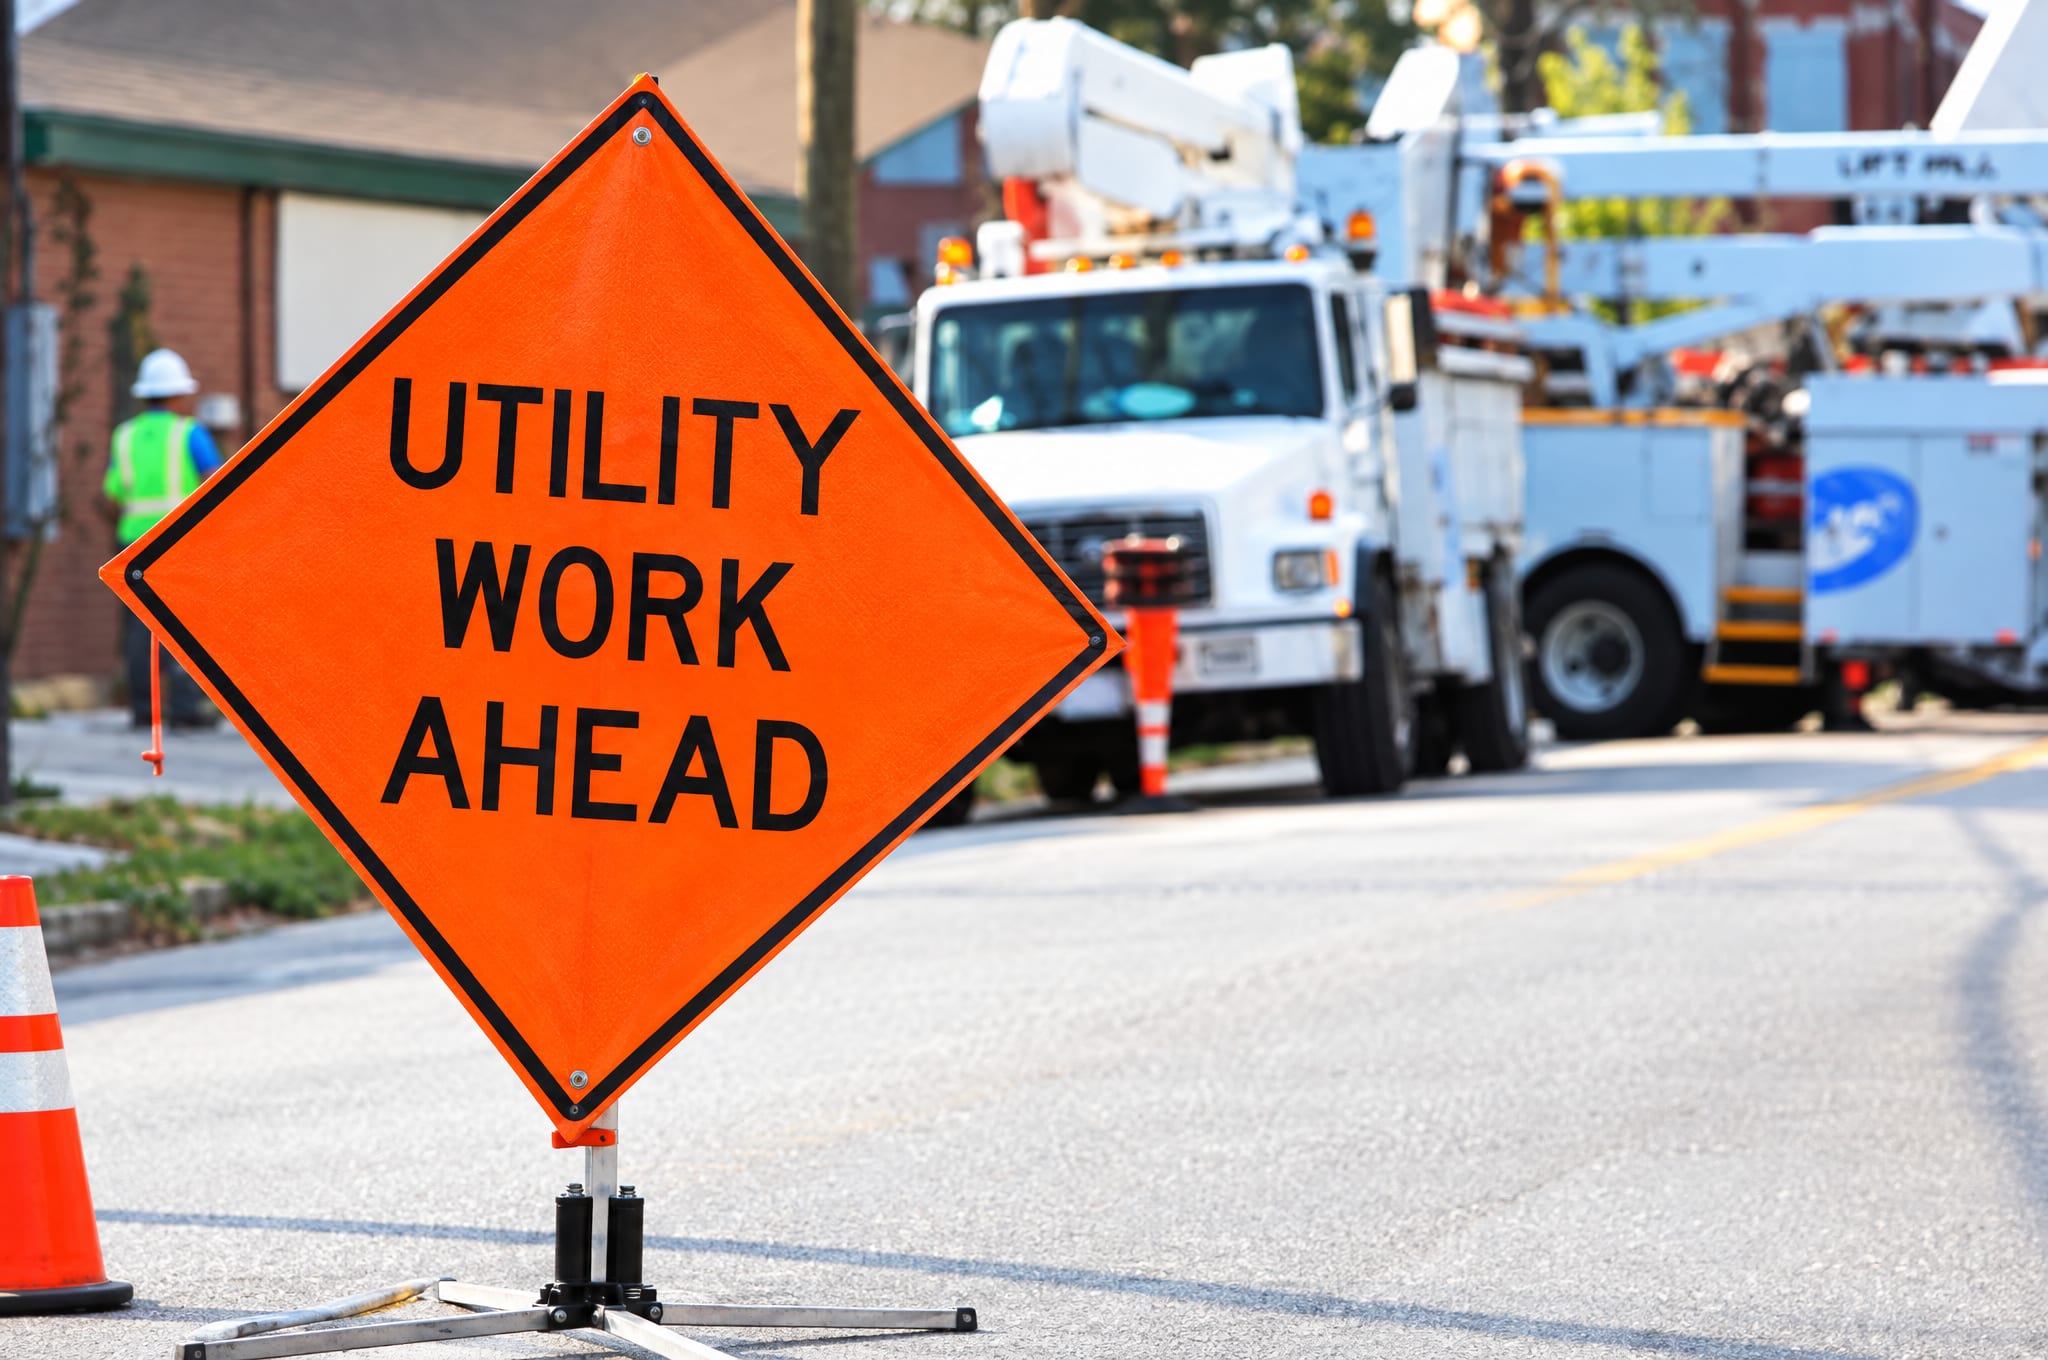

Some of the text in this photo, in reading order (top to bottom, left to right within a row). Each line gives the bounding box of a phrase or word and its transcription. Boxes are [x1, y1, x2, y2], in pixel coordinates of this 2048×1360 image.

[389, 377, 861, 516] UTILITY
[435, 538, 795, 672] WORK
[380, 695, 829, 832] AHEAD
